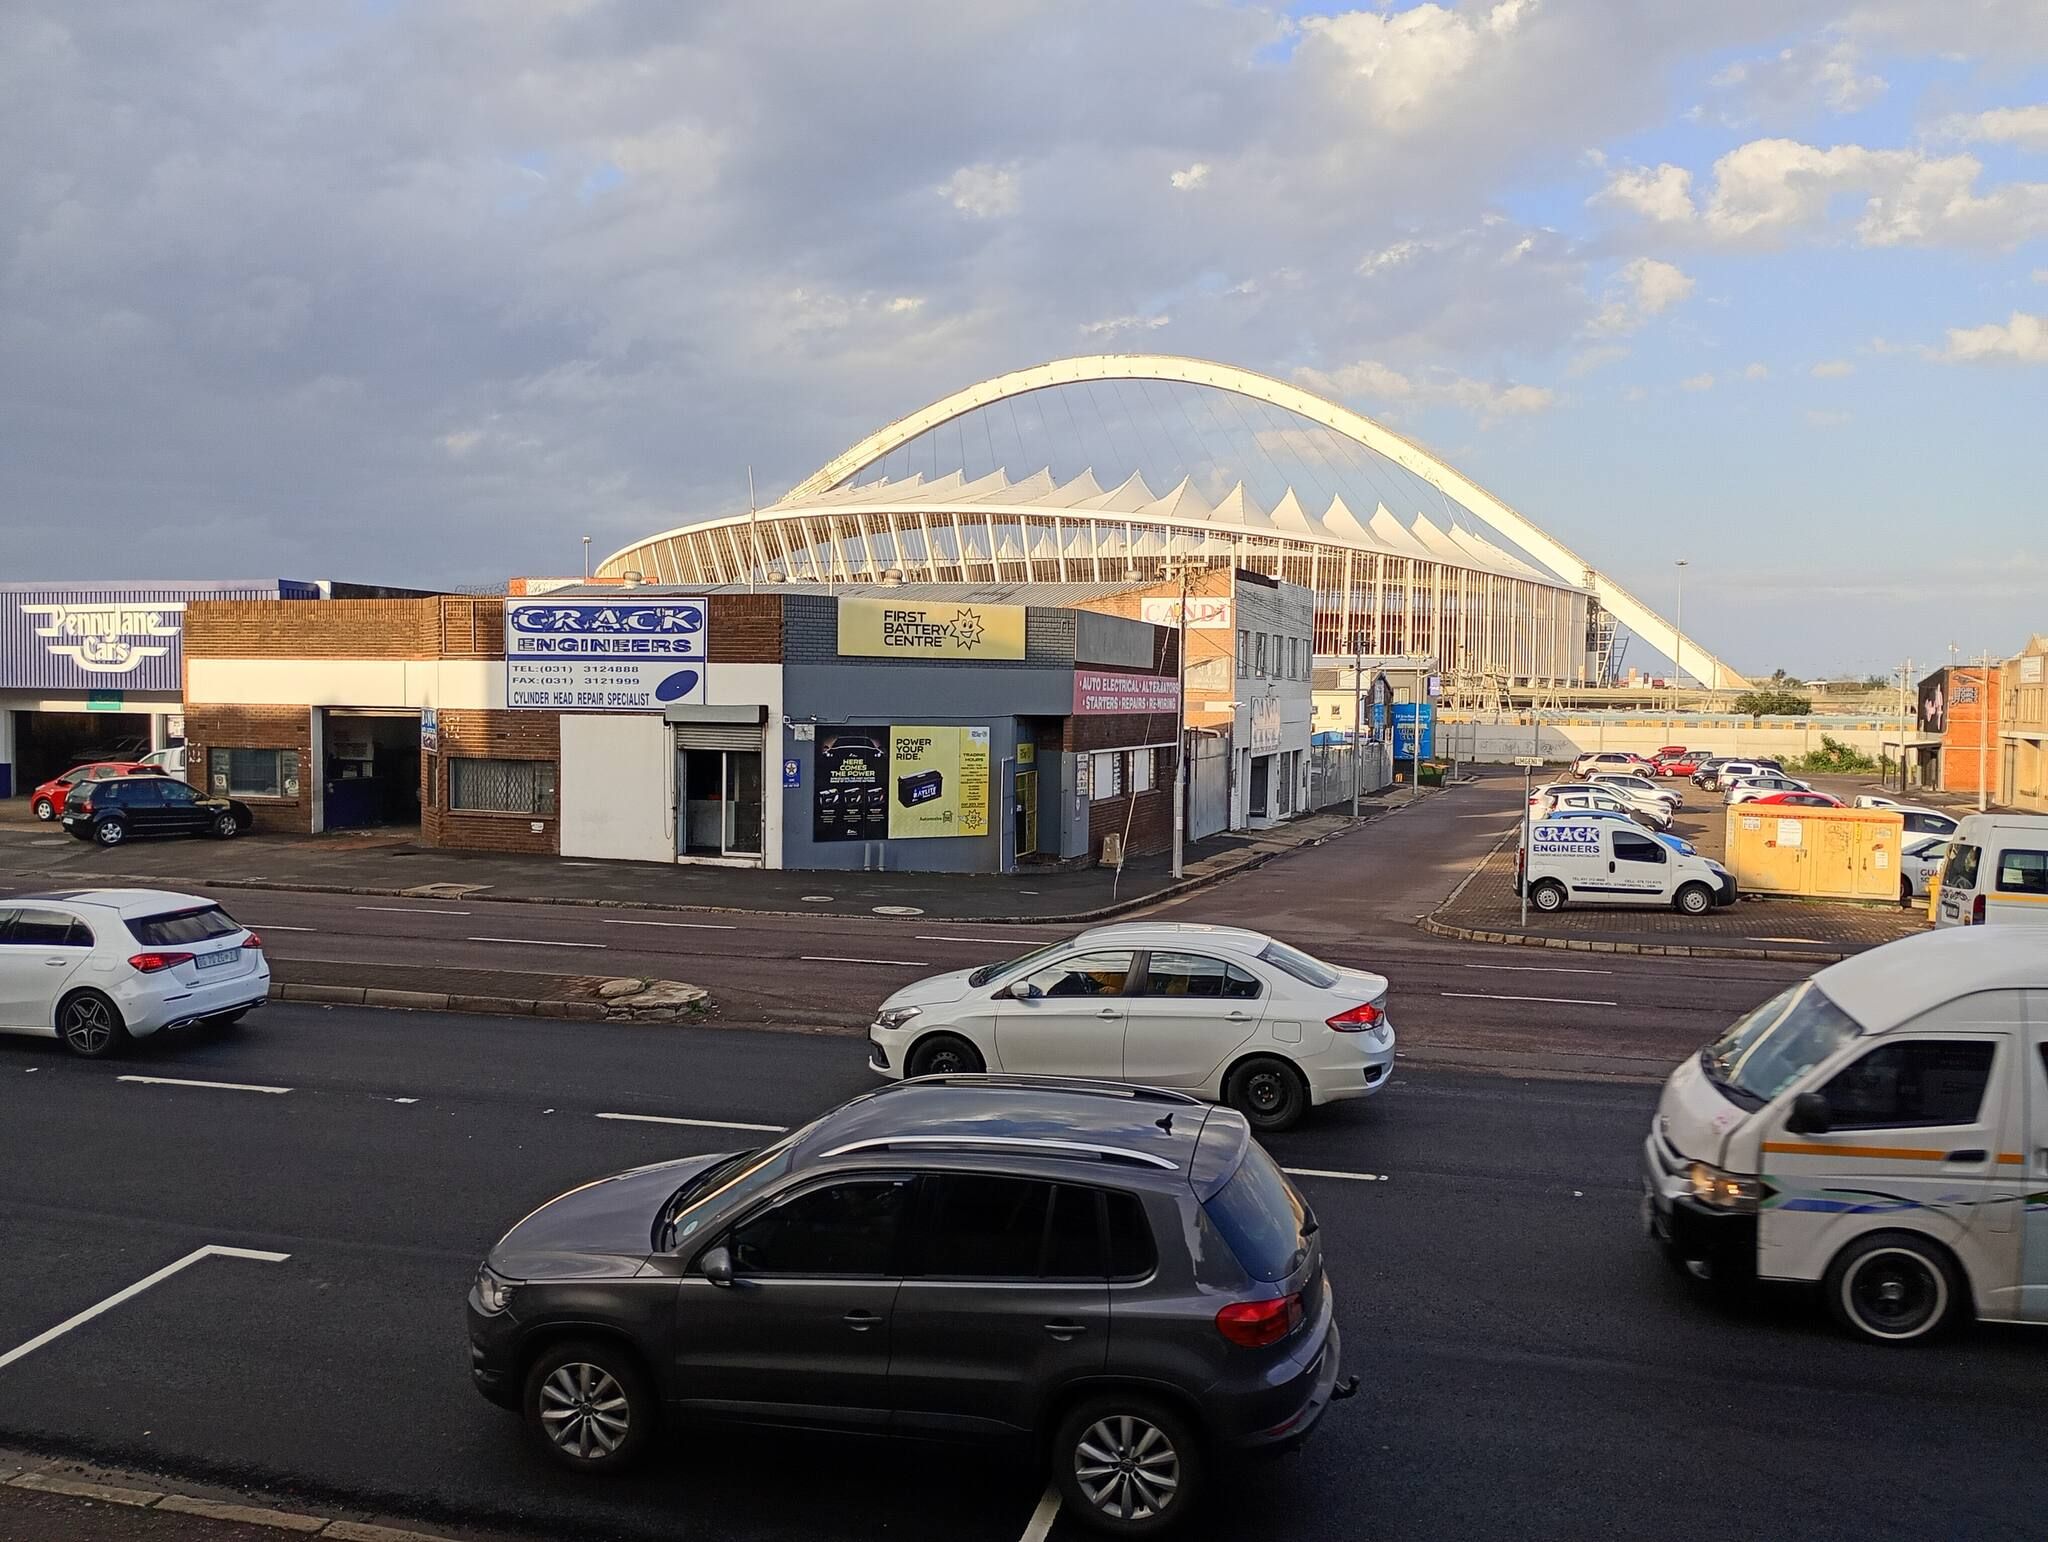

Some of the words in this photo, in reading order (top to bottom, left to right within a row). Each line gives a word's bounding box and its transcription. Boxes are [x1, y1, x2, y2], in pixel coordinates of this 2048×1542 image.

[52, 603, 162, 642] Pennylane
[518, 609, 694, 630] CRACK
[884, 611, 926, 622] FIRST
[884, 623, 950, 635] BATTERY
[83, 636, 130, 661] Cars
[517, 638, 692, 652] ENGINEERS
[584, 665, 639, 673] 3124888
[585, 677, 640, 685] 3121999
[1082, 677, 1101, 691] AUTO
[1102, 678, 1139, 693] ELECTRICAL
[513, 691, 549, 704] CYLINDER
[553, 692, 573, 705] HEAD
[577, 692, 604, 705] REPAIR
[608, 693, 650, 705] SPECIALIST
[1086, 696, 1119, 709] STARTERS
[1121, 697, 1146, 709] REPAIRS
[896, 738, 932, 746] POWER
[1534, 827, 1599, 842] CRACK
[1533, 844, 1600, 853] ENGINEERS
